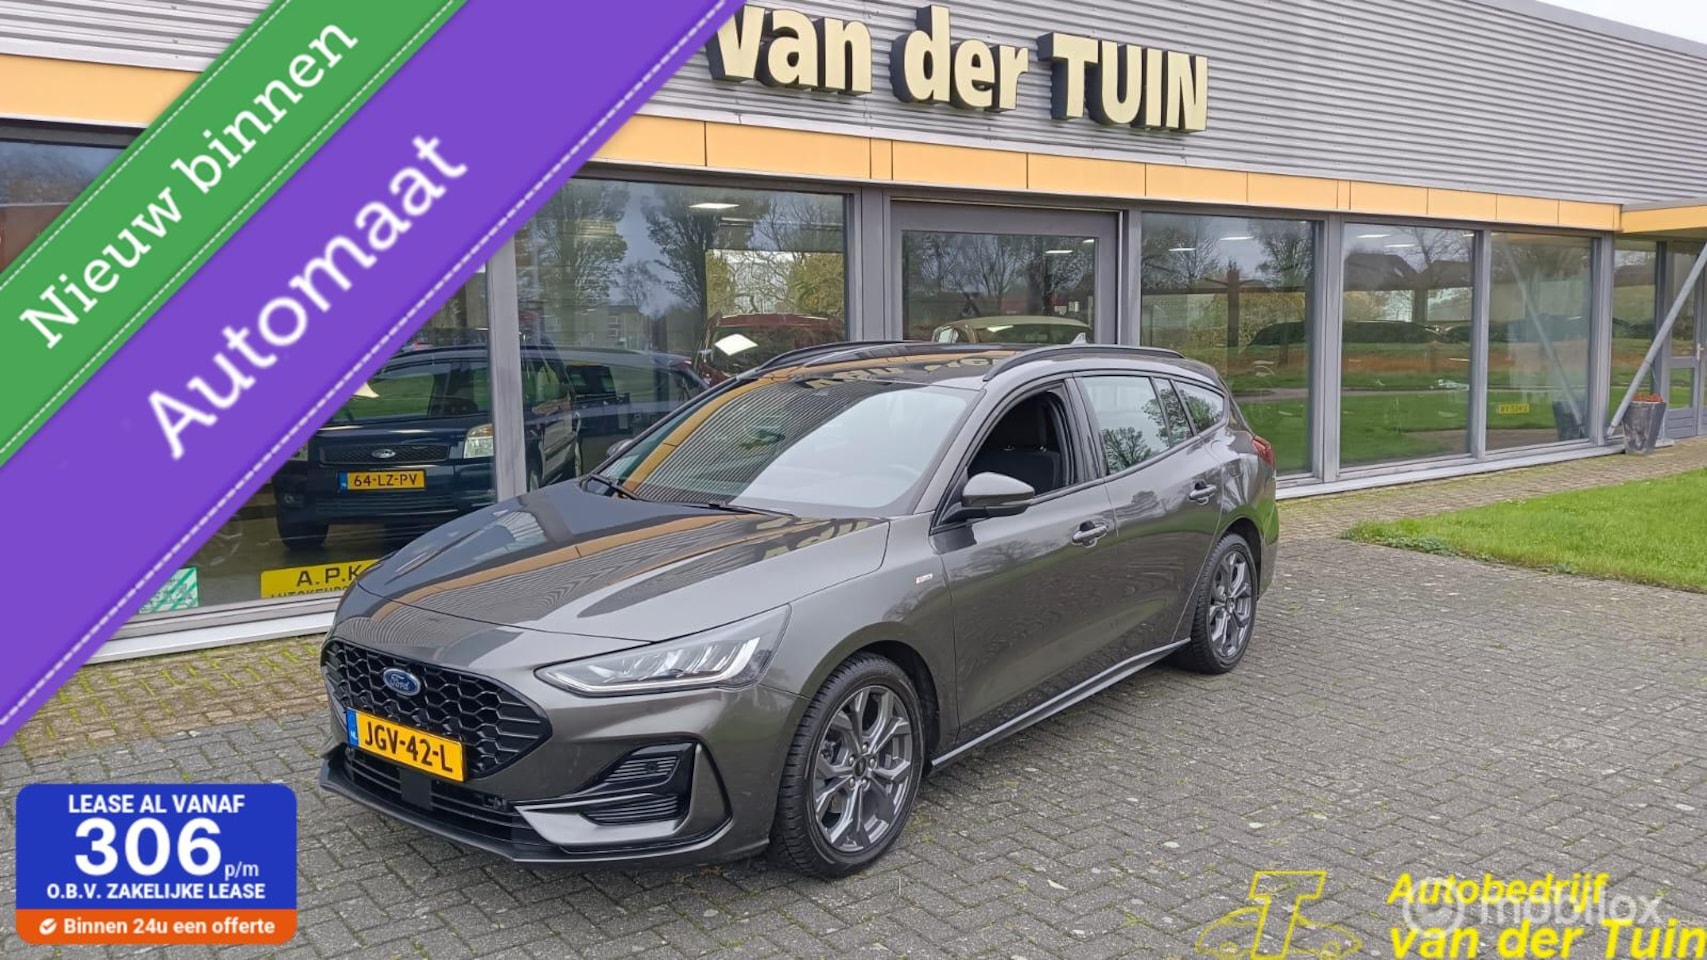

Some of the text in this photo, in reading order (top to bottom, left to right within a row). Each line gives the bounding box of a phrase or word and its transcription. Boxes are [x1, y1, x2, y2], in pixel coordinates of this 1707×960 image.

[712, 4, 1208, 132] van der TUIN
[354, 474, 417, 486] 64-LZ-PV
[364, 721, 453, 773] JGV-42-L
